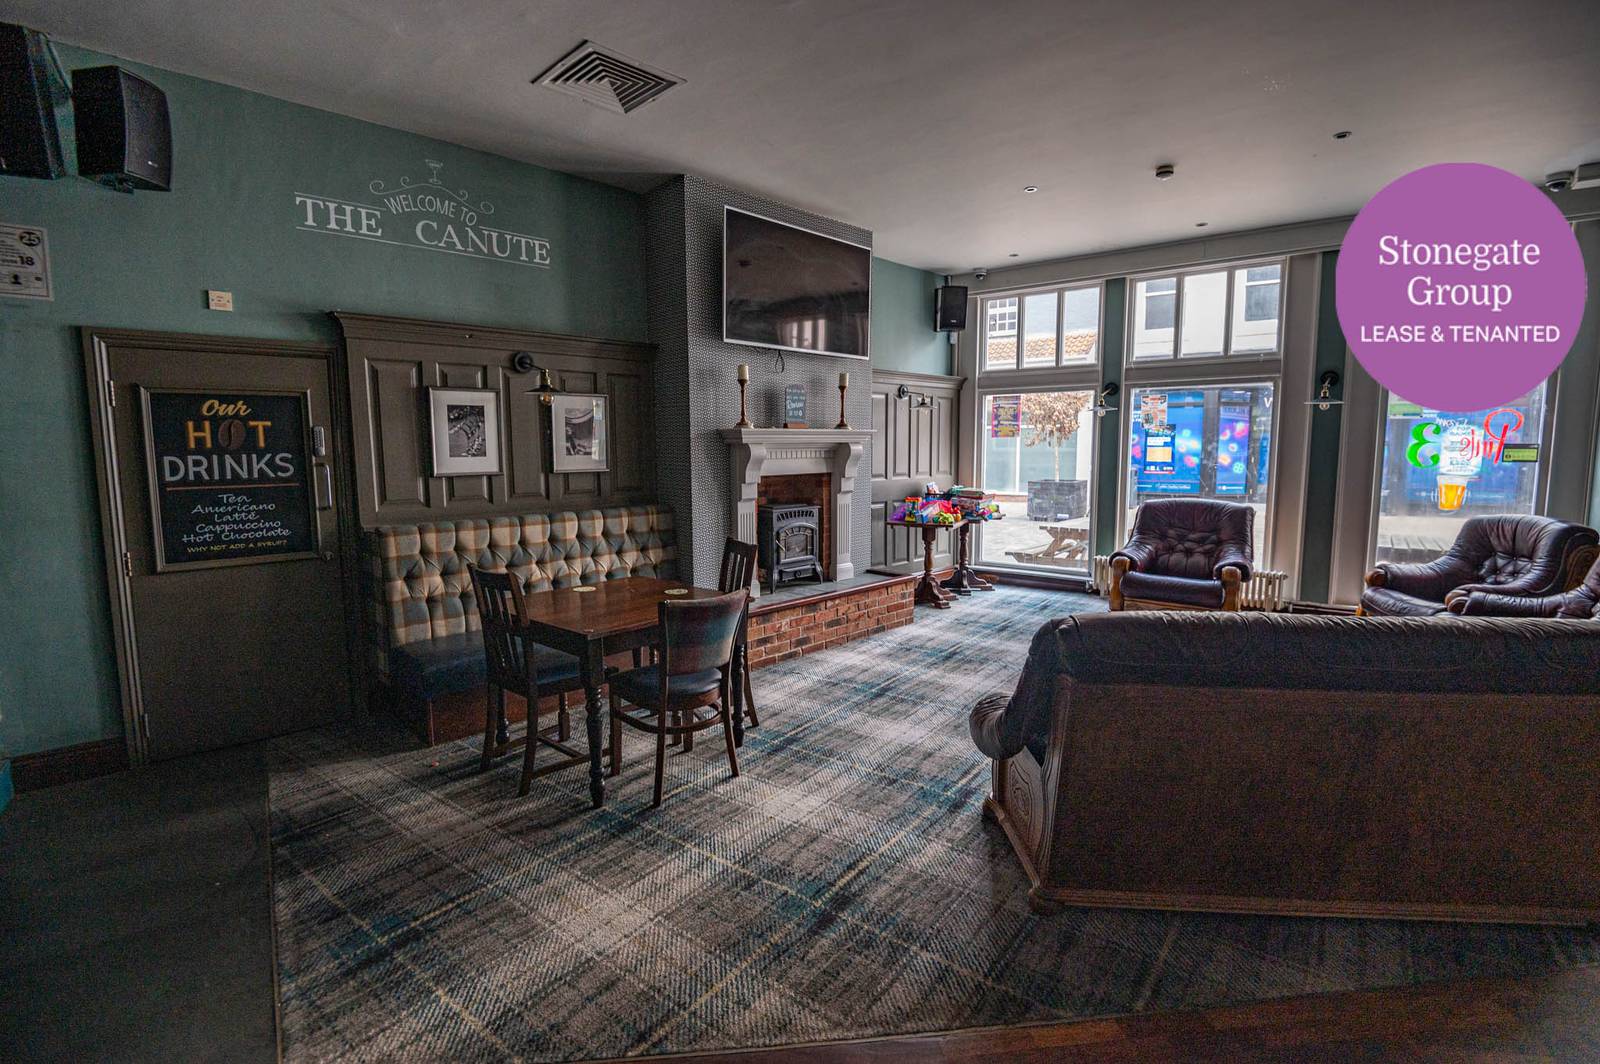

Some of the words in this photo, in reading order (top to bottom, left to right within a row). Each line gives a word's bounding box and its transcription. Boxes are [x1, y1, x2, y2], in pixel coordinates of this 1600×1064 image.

[384, 194, 456, 219] WELCOME
[460, 206, 477, 226] TO
[296, 196, 382, 237] THE
[415, 220, 550, 265] CANUTE
[202, 399, 252, 417] Our
[163, 452, 295, 482] DRINKS
[218, 493, 252, 504] Tea
[191, 503, 276, 514] Americano
[181, 533, 214, 543] Hot
[221, 528, 292, 541] Chocolate
[195, 520, 281, 535] Cappuccino
